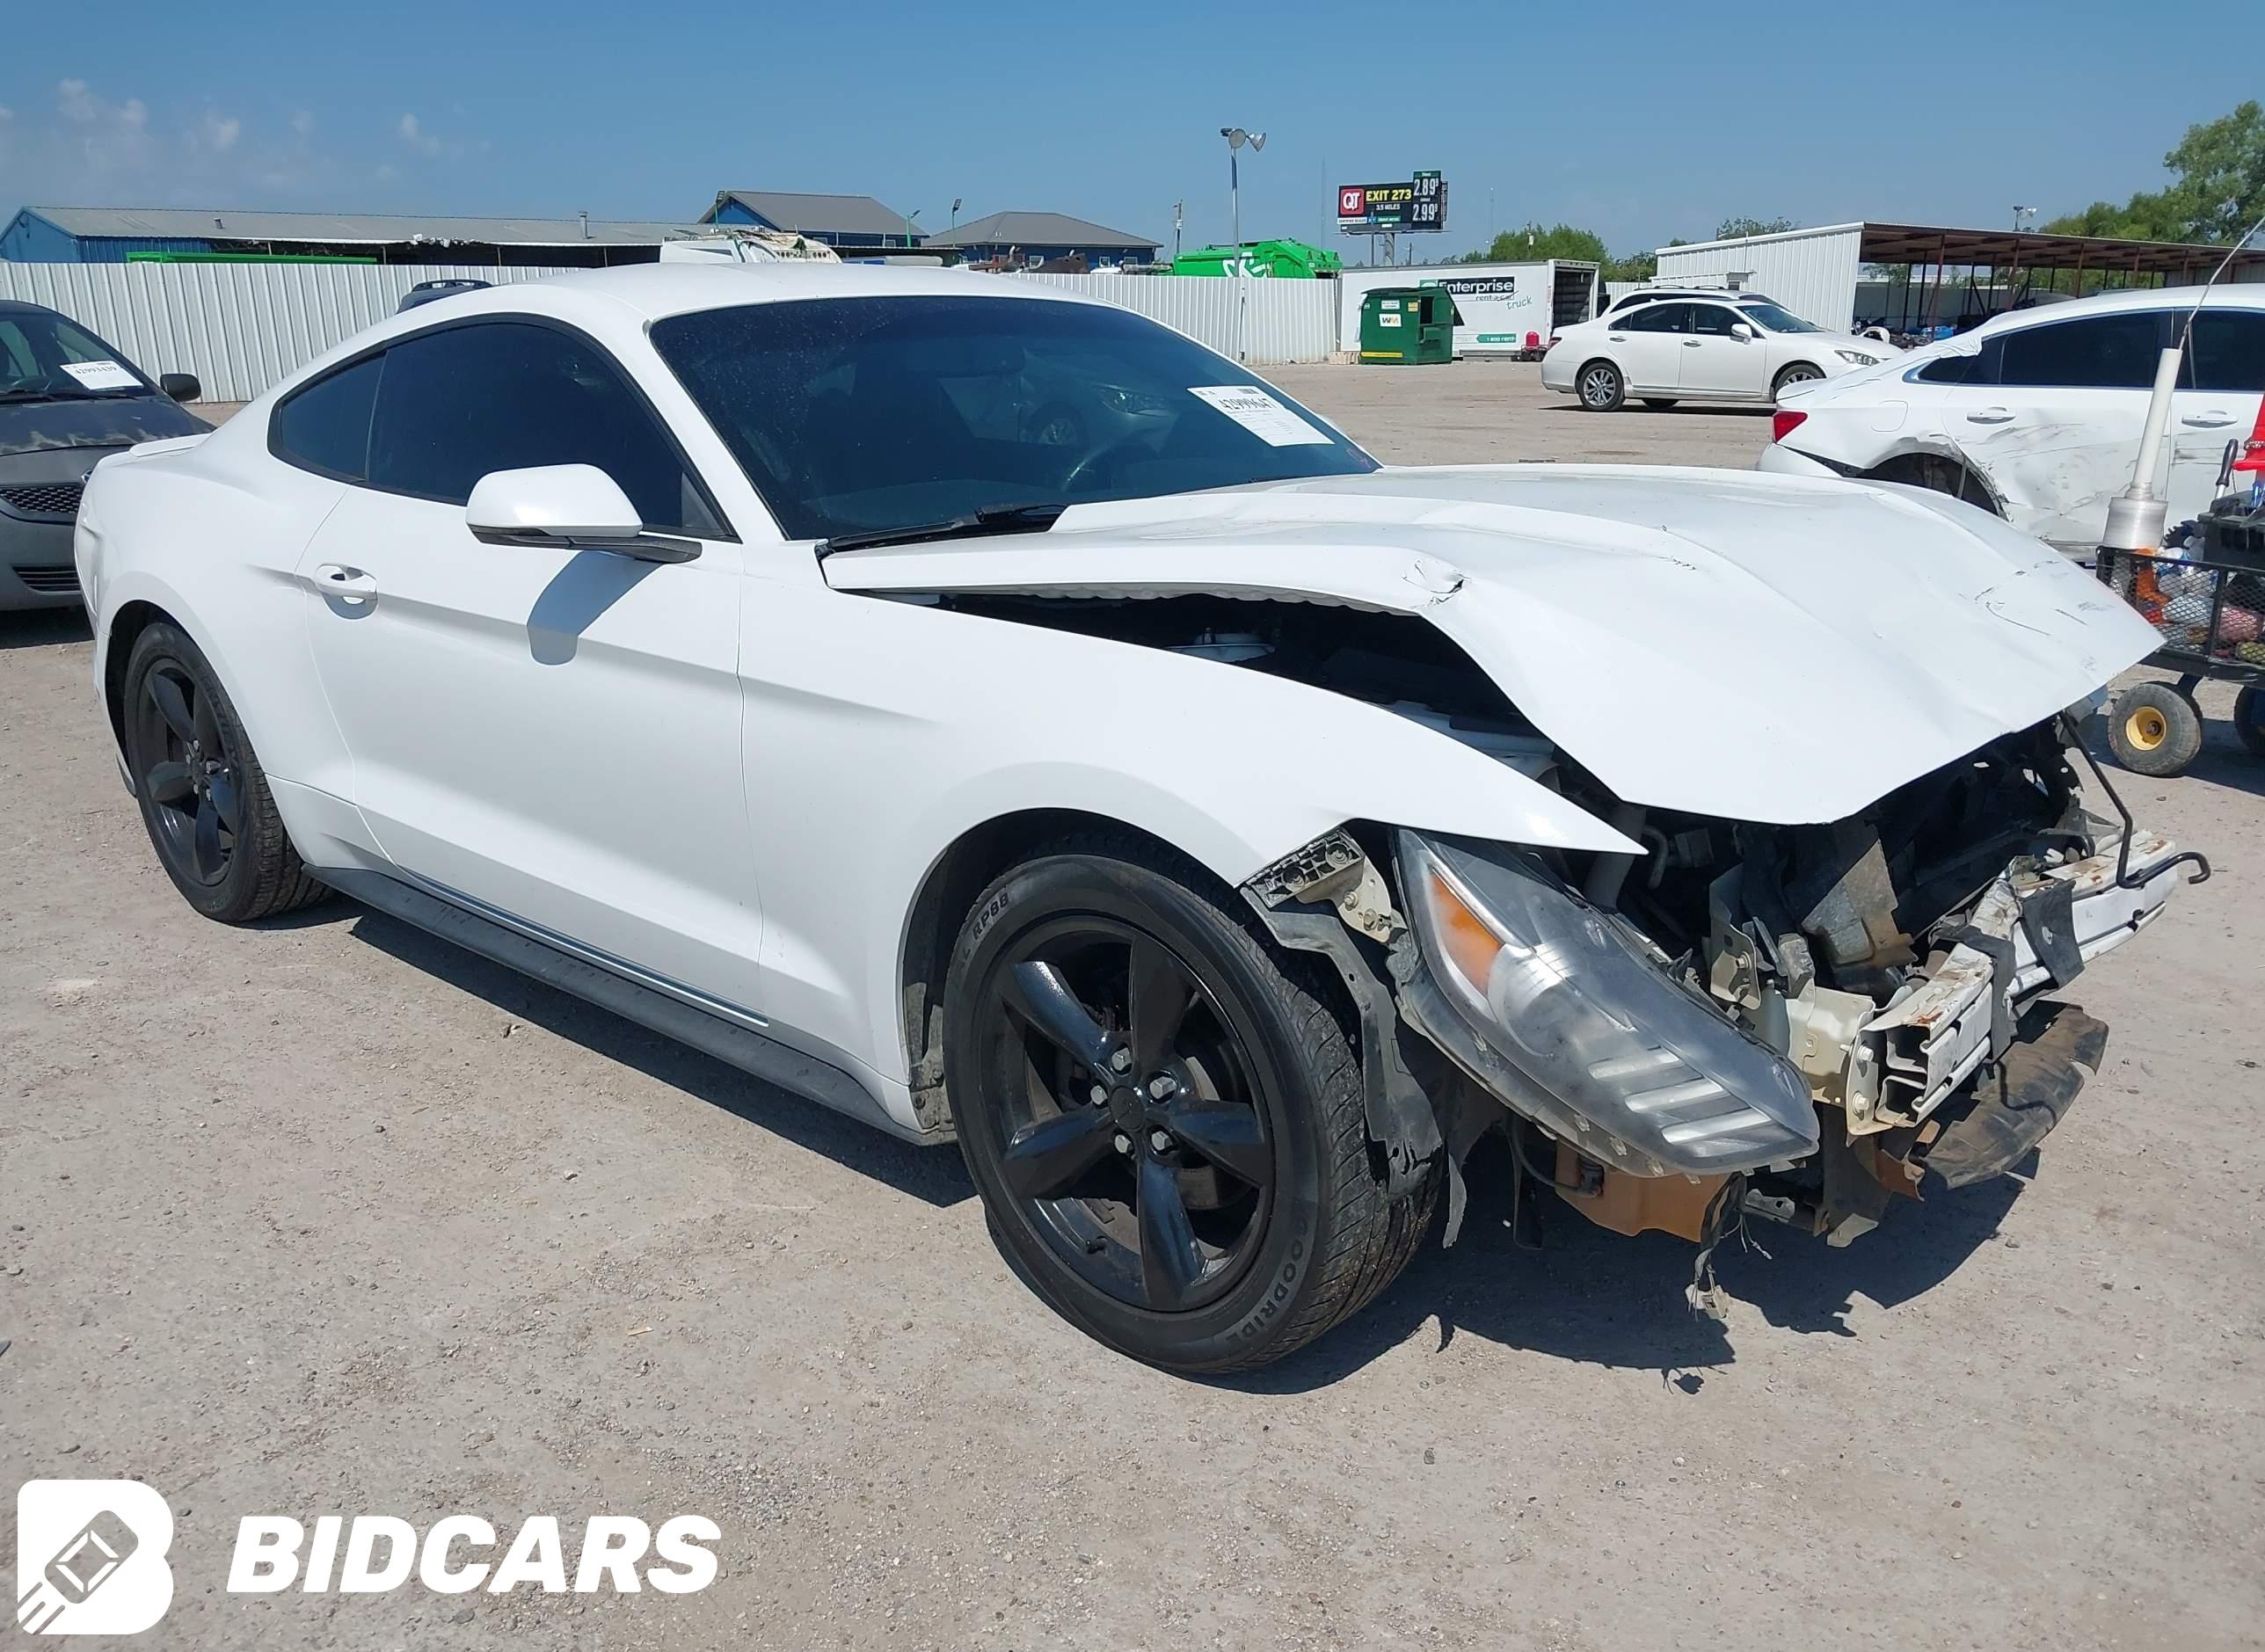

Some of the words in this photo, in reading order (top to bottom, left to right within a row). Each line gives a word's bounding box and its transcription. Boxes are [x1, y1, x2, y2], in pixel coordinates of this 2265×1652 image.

[1343, 192, 1360, 211] QT
[1366, 190, 1389, 202] EXIT
[1391, 188, 1412, 201] 273
[1506, 295, 1533, 310] truck
[972, 891, 1009, 941] RP88
